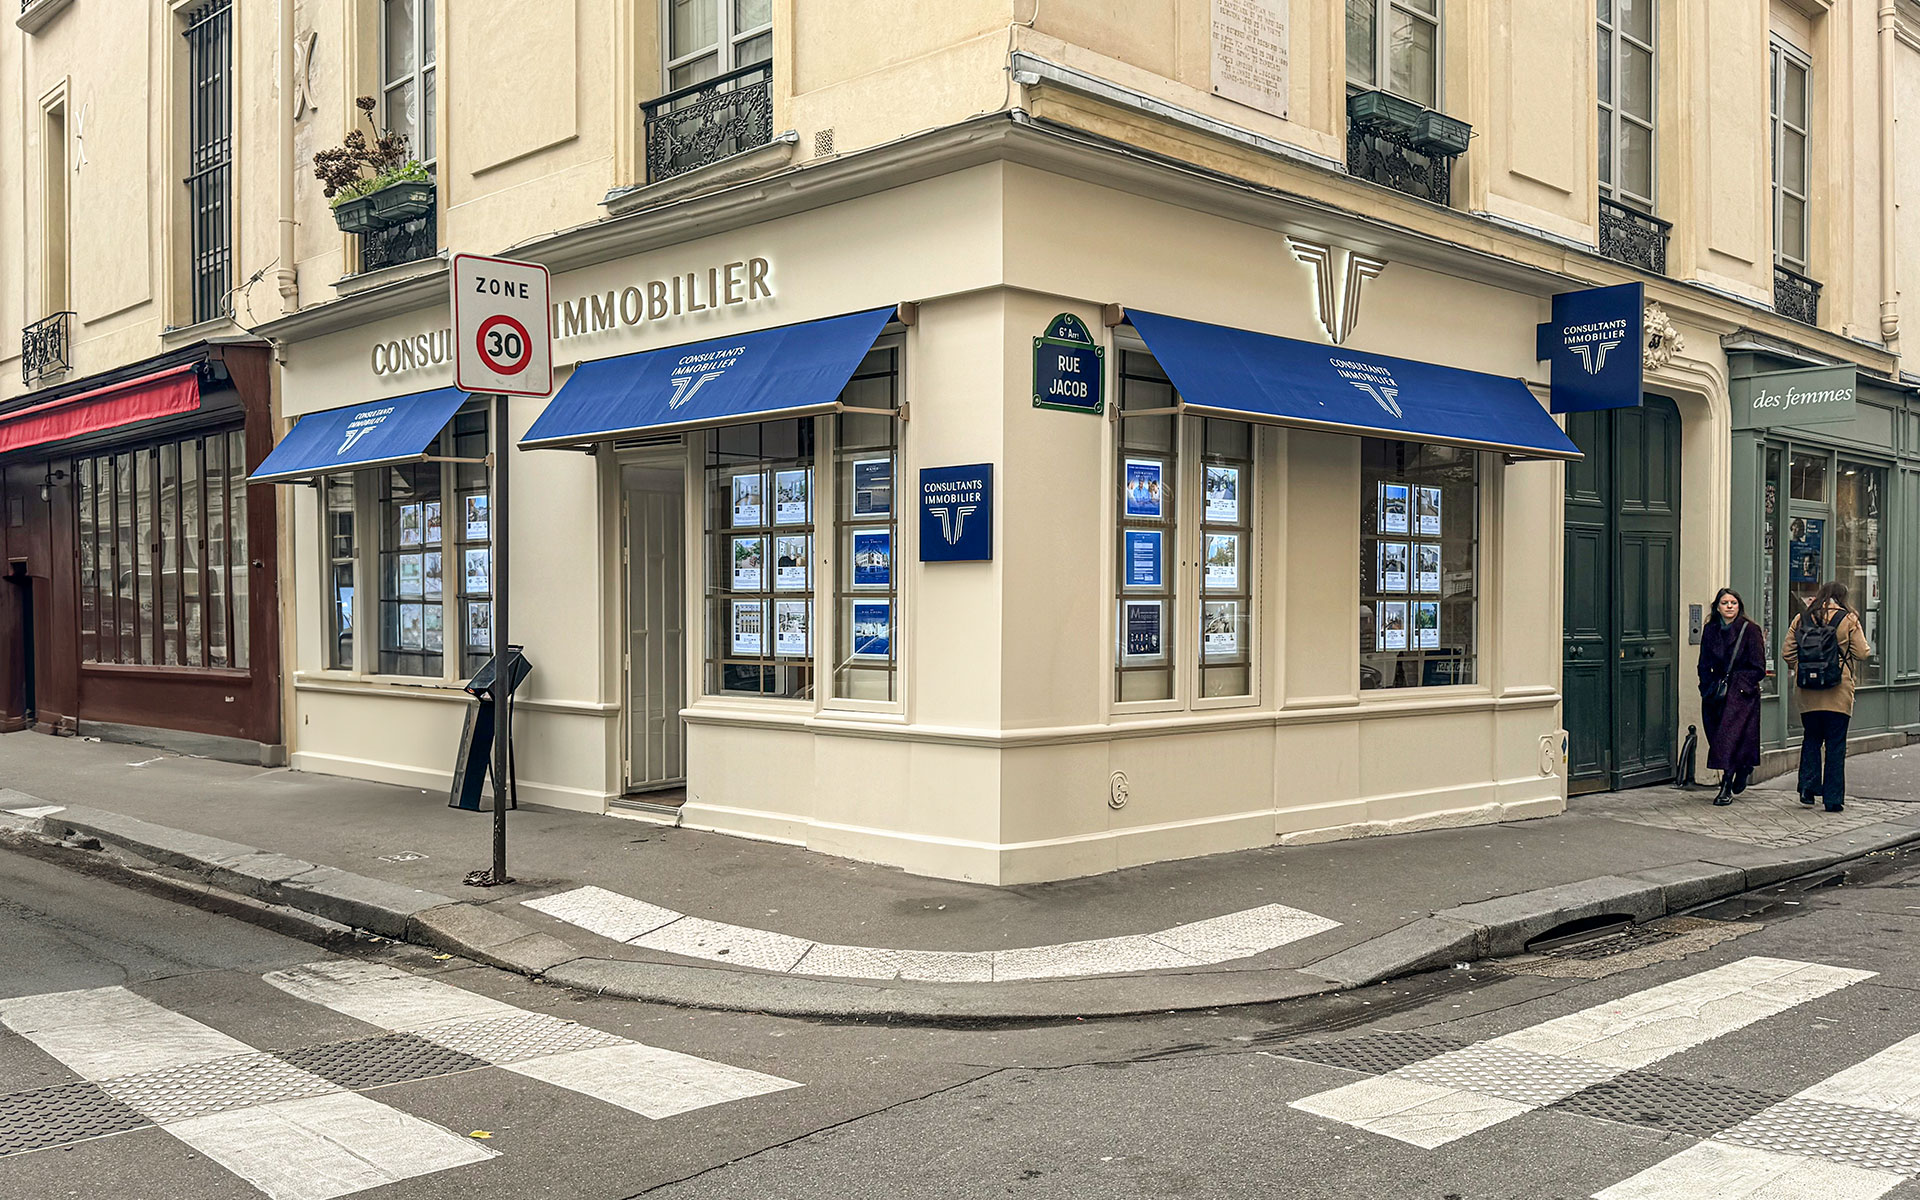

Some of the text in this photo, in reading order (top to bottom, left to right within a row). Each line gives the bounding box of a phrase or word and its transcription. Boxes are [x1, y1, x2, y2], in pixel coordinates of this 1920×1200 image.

[475, 277, 529, 299] ZONE
[371, 257, 772, 376] CONSUL IMMOBILIER
[1563, 319, 1627, 335] CONSULTANTS
[487, 331, 522, 359] 30
[1564, 329, 1625, 345] IMMOBILIER
[1648, 333, 1663, 350] 33
[678, 346, 746, 365] CONSULTANTS
[1058, 355, 1081, 373] RUE
[671, 358, 737, 377] IMMOBILIER
[1329, 357, 1392, 376] CONSULTANTS
[1337, 369, 1398, 387] IMMOBILIER
[1049, 378, 1088, 398] JACOB
[1753, 387, 1853, 410] des femmes
[924, 479, 983, 493] CONSULTANTS
[925, 492, 981, 505] IMMOBILIER
